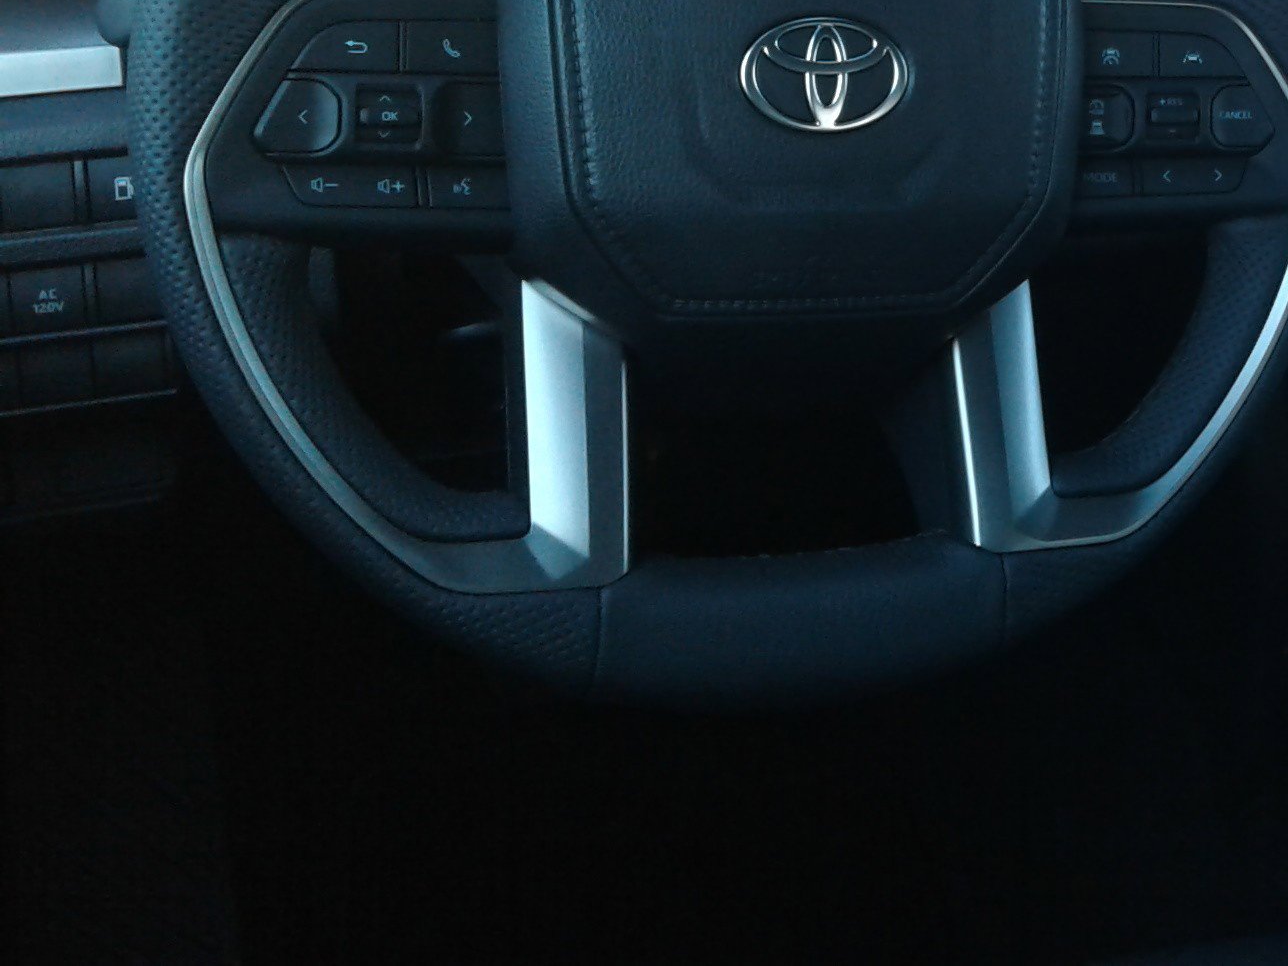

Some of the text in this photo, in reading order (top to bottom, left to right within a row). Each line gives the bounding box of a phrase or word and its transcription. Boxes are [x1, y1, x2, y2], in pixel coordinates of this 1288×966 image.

[381, 111, 398, 121] OK
[1219, 111, 1253, 120] CANCEL
[38, 288, 57, 299] AC
[32, 300, 64, 314] 120V
